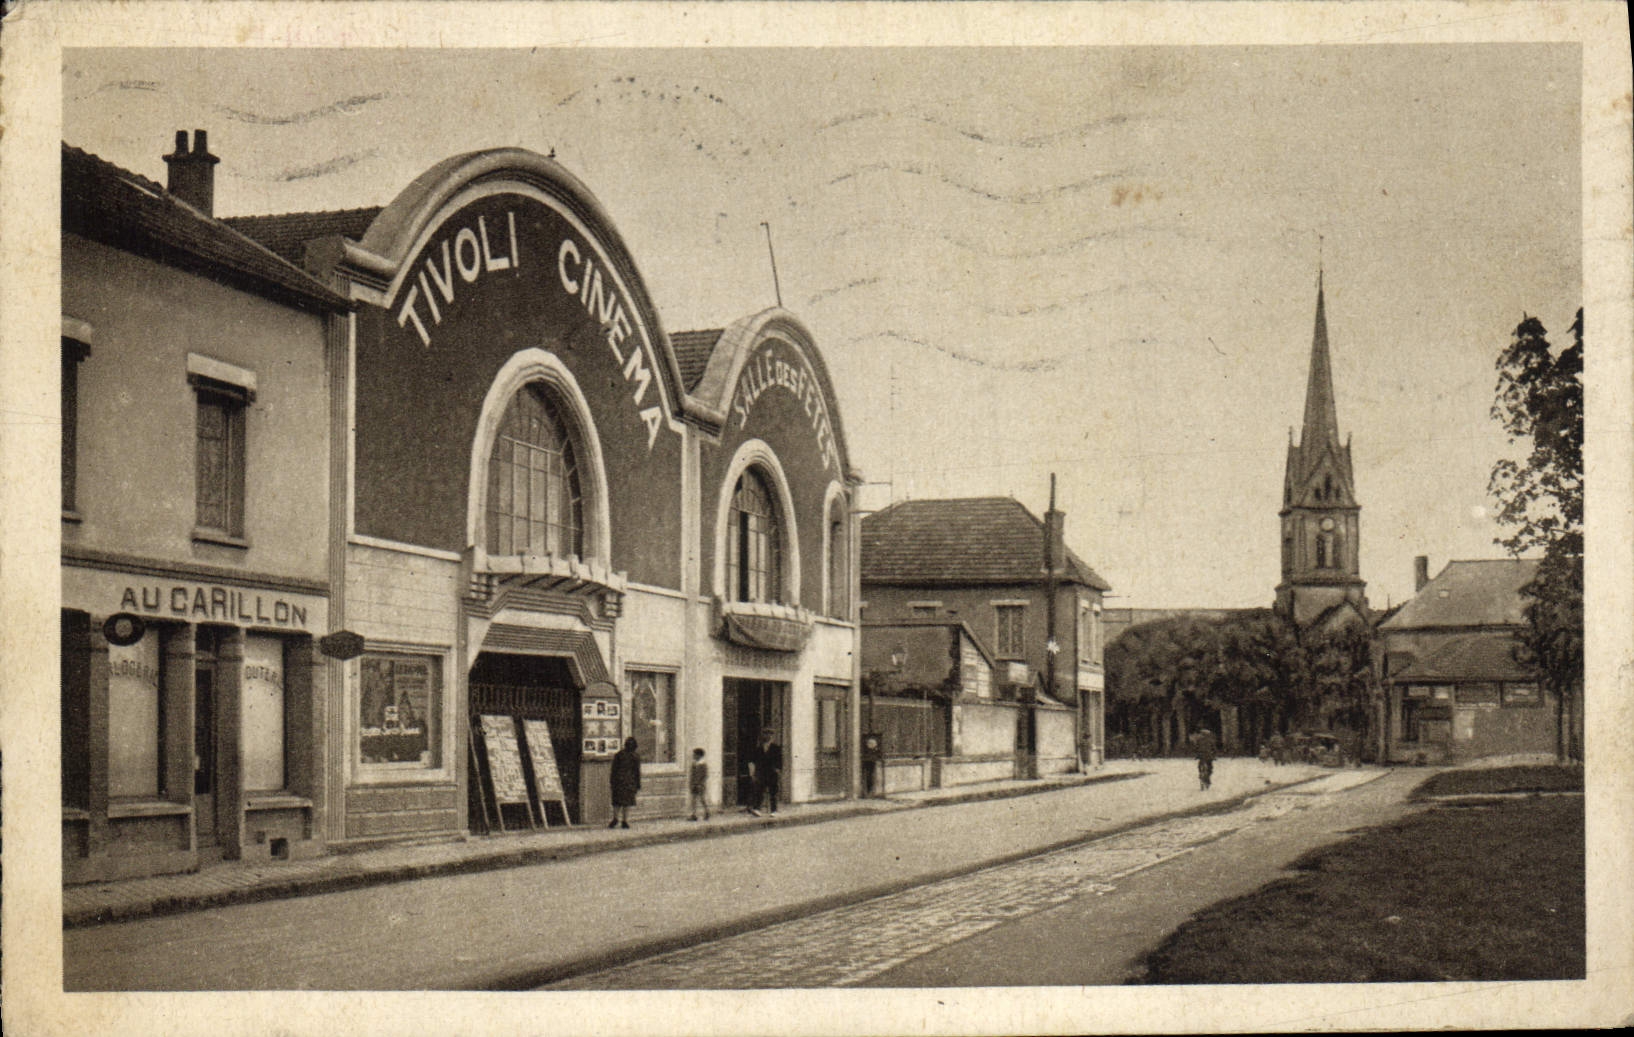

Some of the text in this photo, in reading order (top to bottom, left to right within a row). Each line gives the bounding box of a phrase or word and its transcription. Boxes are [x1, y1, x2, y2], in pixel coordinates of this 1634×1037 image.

[397, 211, 663, 450] TIVOLI CINEMA
[733, 349, 775, 431] SALLE
[775, 360, 798, 393] DES
[120, 586, 308, 626] AU CARILLON
